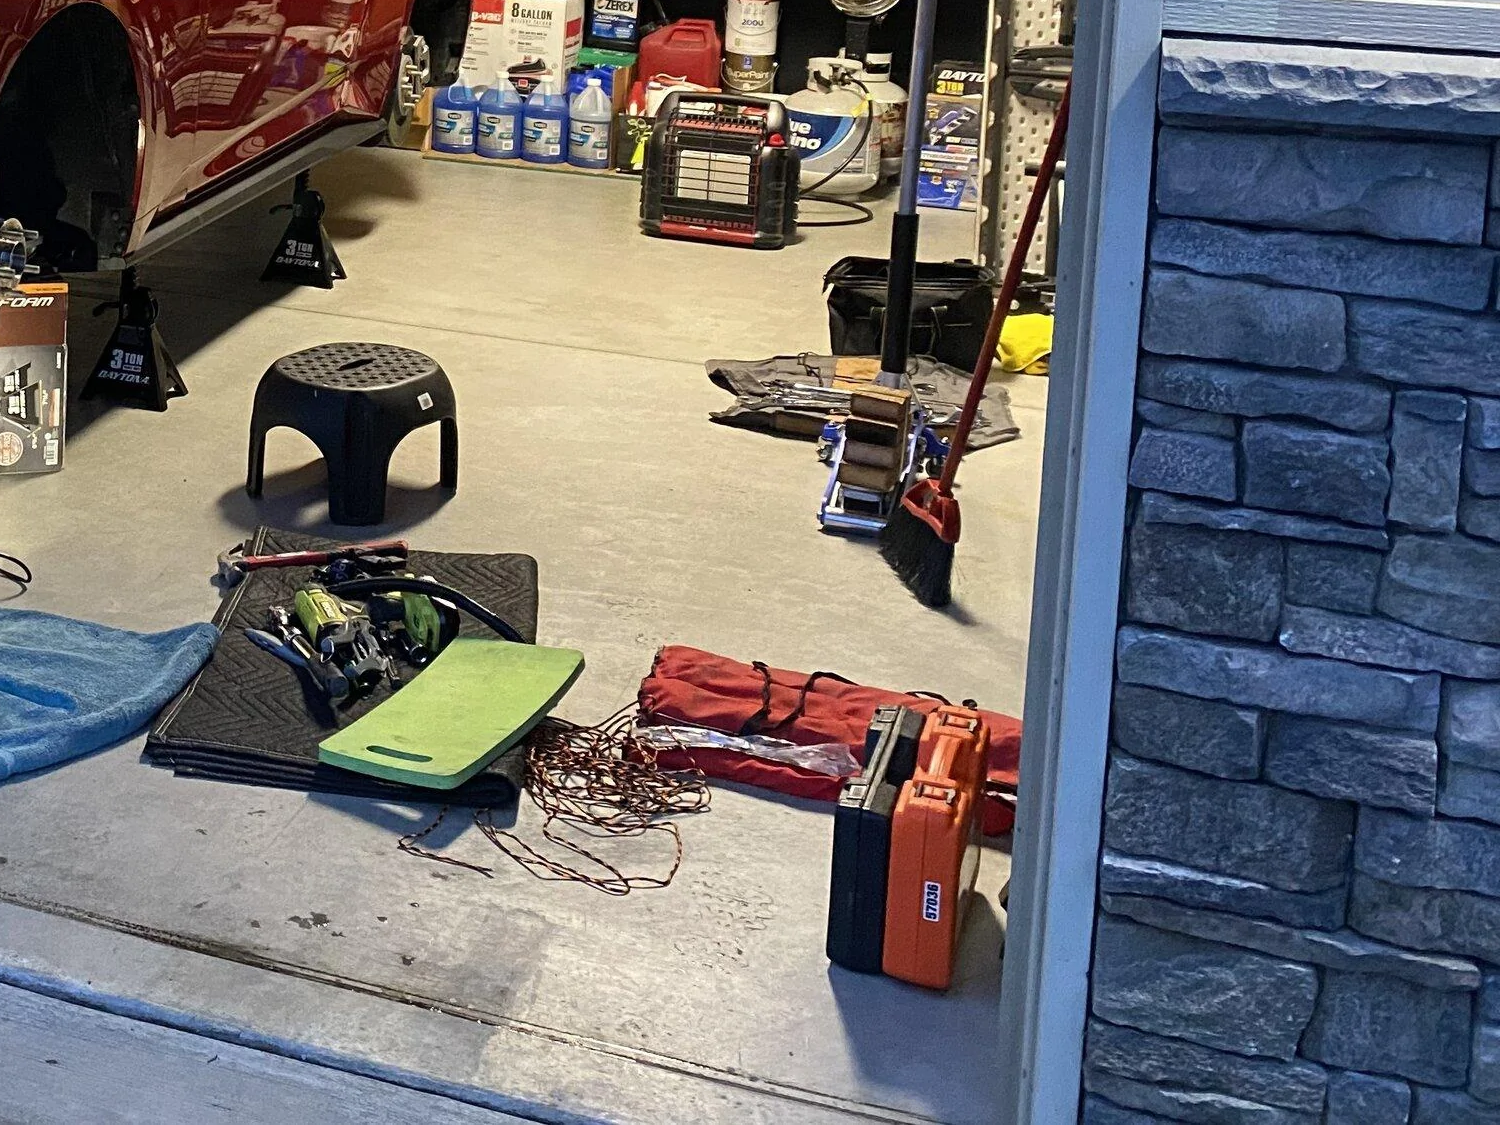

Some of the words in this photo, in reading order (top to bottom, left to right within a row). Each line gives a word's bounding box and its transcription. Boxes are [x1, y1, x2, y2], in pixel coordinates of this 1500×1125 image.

[511, 2, 520, 18] 8
[521, 9, 553, 21] GALLON
[938, 69, 985, 82] DAYTO
[936, 80, 946, 94] 3
[946, 81, 964, 92] TON
[789, 119, 812, 135] ue
[790, 132, 819, 150] ino
[285, 239, 297, 256] 3
[297, 242, 313, 253] TON
[110, 349, 124, 369] 3
[124, 352, 144, 366] TON
[98, 370, 150, 384] DAYTONA
[925, 884, 939, 920] 57036
